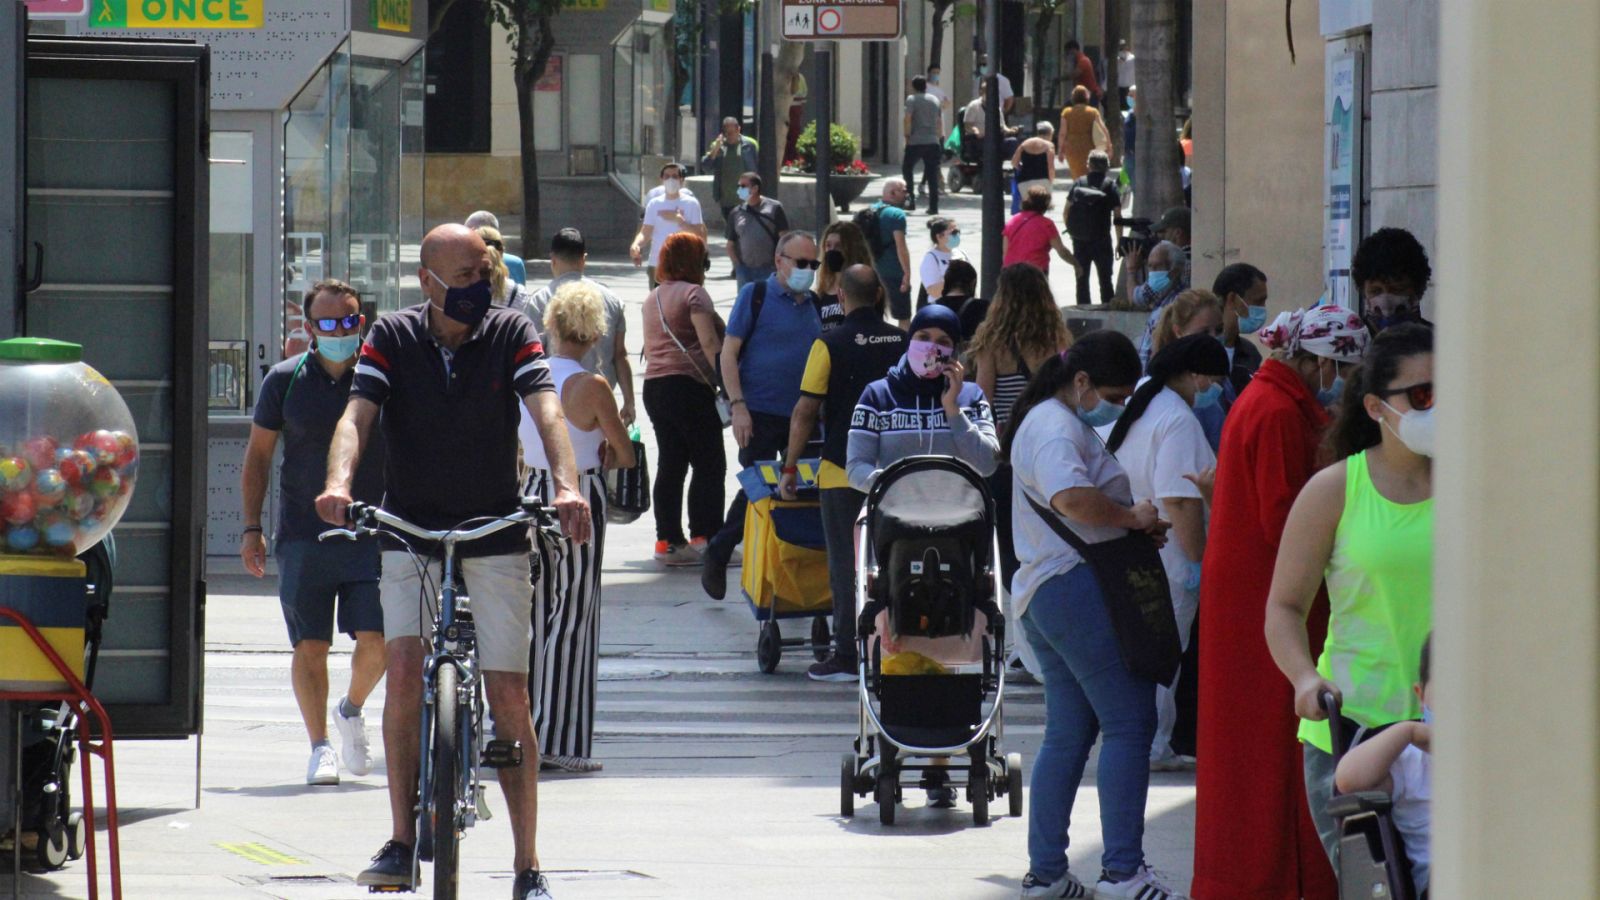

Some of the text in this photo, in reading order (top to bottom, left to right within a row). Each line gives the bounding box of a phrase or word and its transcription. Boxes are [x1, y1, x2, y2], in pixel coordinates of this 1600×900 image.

[141, 0, 249, 21] ONCE
[379, 0, 409, 25] ONCE
[869, 335, 902, 344] Correos
[891, 412, 923, 429] RULES
